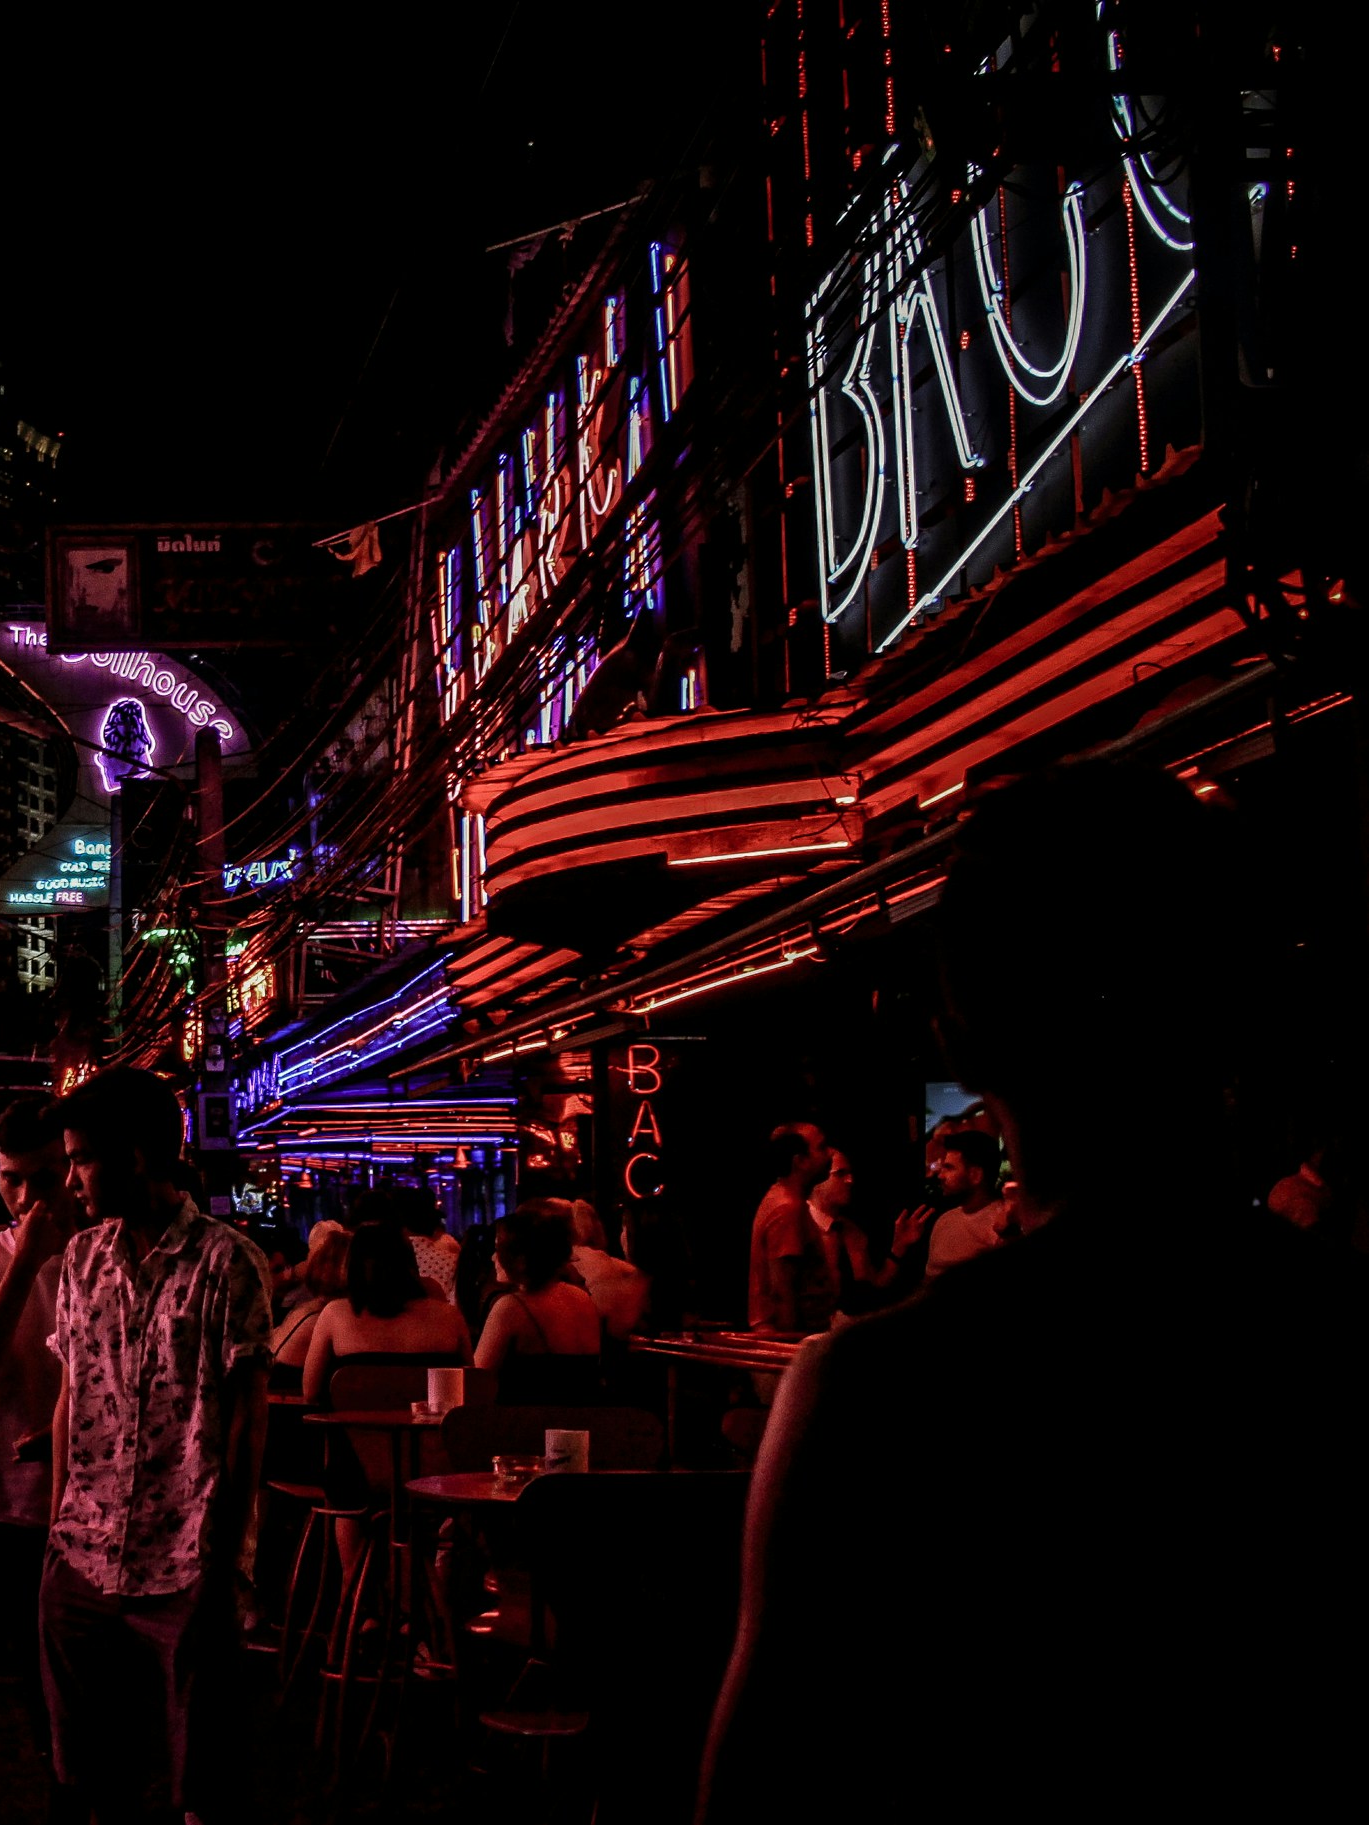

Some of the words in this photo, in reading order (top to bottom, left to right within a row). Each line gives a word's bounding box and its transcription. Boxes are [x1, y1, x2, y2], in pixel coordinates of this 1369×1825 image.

[9, 626, 47, 647] The
[60, 652, 234, 740] ollhouse
[10, 893, 54, 904] HASSLE
[56, 892, 83, 903] FREE
